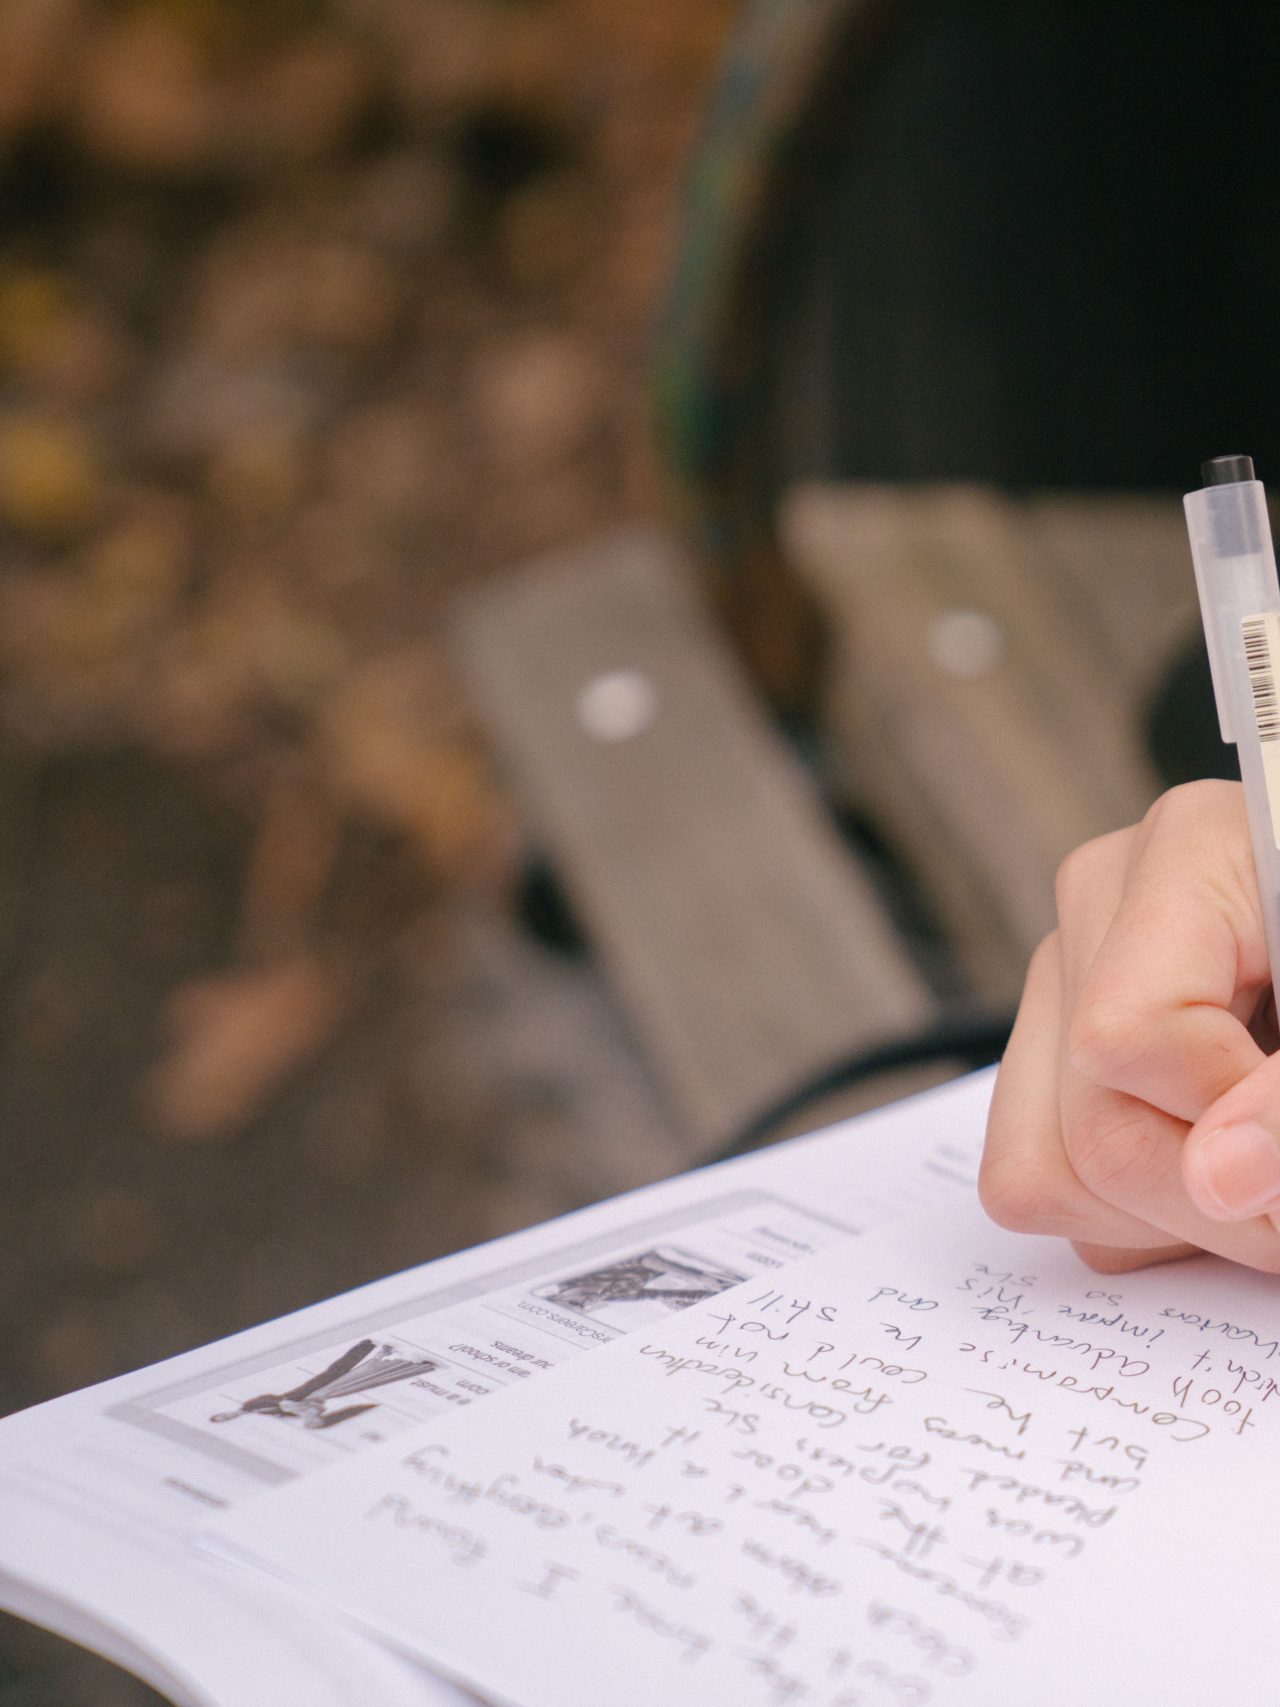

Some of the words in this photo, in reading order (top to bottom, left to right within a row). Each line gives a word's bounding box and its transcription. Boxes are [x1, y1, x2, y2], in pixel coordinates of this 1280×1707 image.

[746, 1289, 837, 1324] still
[866, 1286, 939, 1312] and
[706, 1312, 789, 1342] not
[878, 1323, 922, 1350] he
[695, 1336, 758, 1363] him
[782, 1362, 893, 1414] from
[962, 1389, 1032, 1435] he
[1067, 1427, 1149, 1470] but
[730, 1449, 835, 1500] door
[1056, 1459, 1140, 1496] and
[876, 1498, 949, 1559] the
[985, 1507, 1084, 1559] was
[958, 1555, 1046, 1591] at
